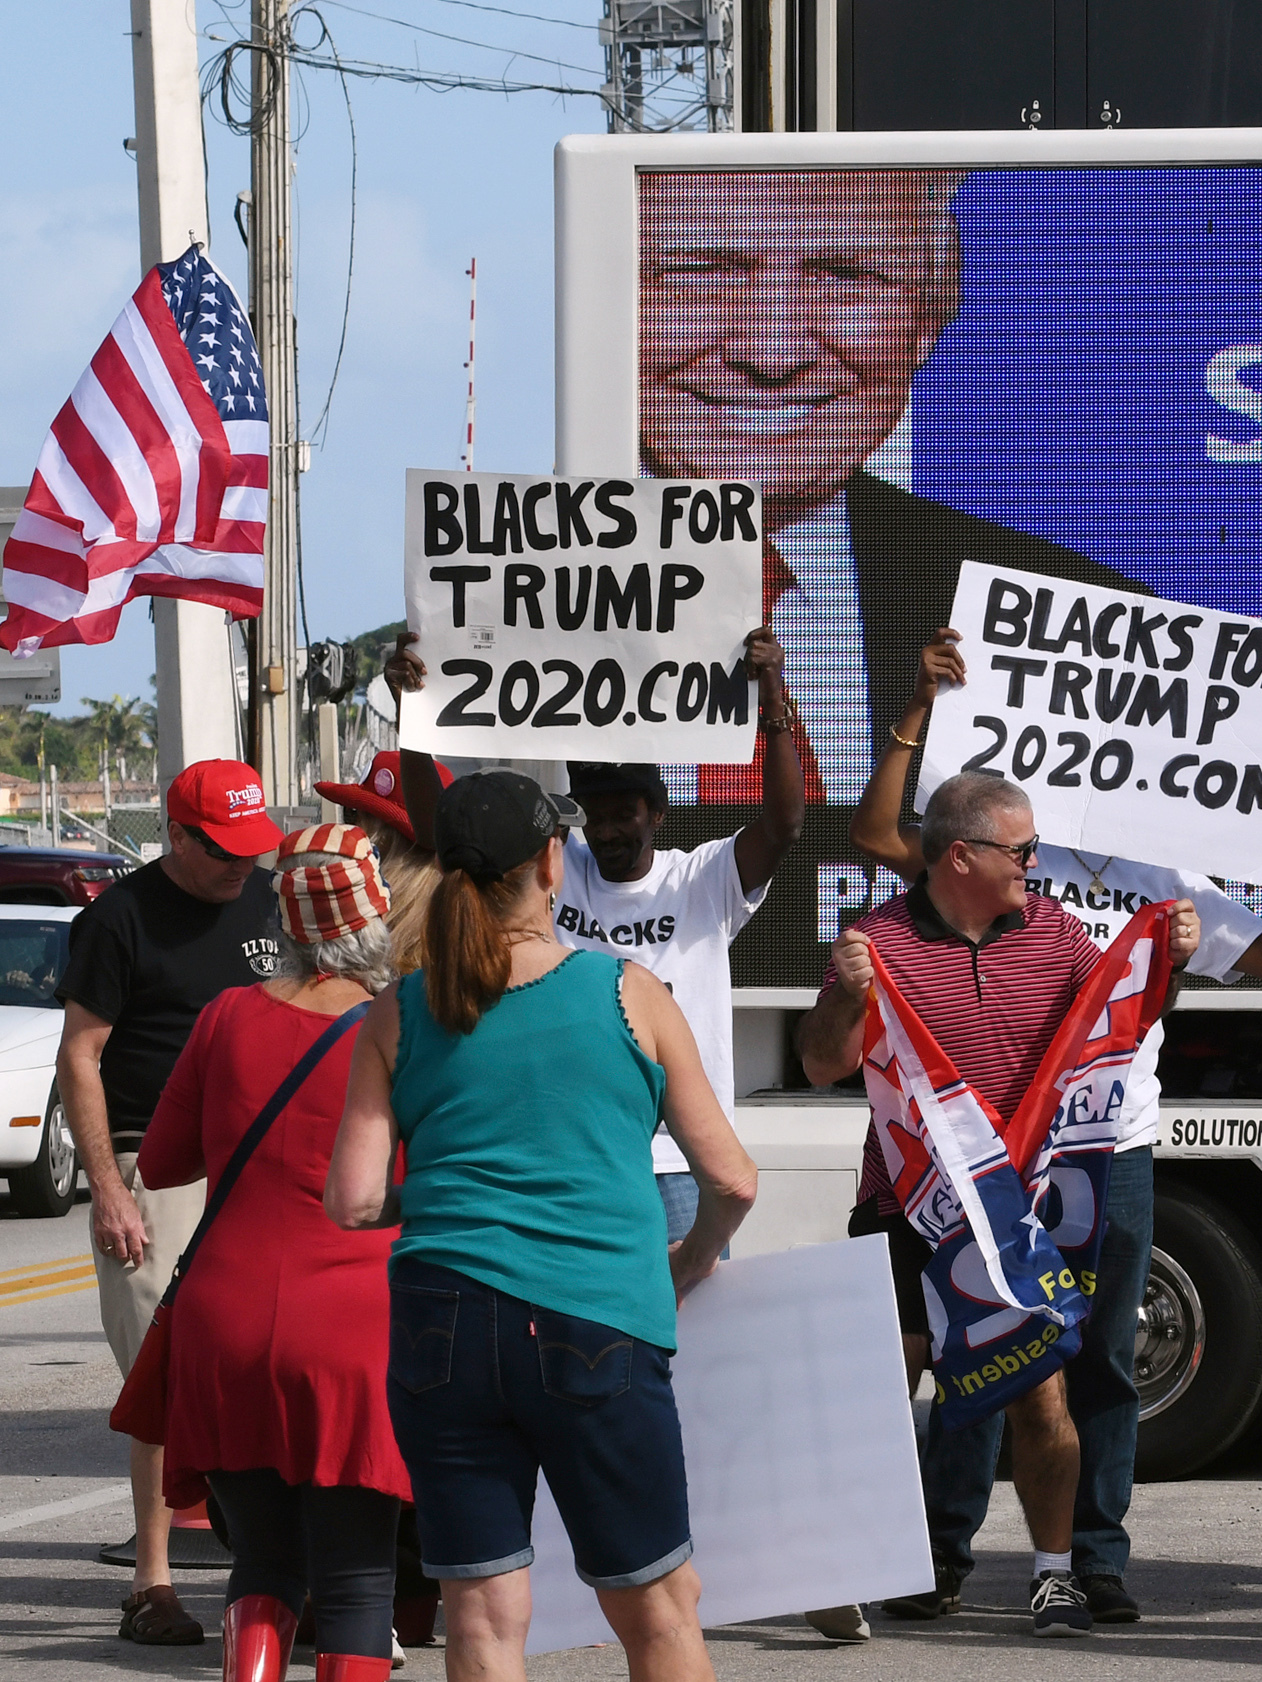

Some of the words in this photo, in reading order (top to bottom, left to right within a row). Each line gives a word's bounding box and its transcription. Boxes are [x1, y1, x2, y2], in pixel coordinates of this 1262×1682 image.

[423, 480, 637, 557] BLACKS
[659, 483, 758, 550] FOR
[429, 563, 705, 633] TRUMP
[982, 578, 1204, 672] BLACKS
[436, 658, 750, 728] 2020.COM
[990, 655, 1241, 745] TRUMP
[241, 939, 259, 957] ZZ
[556, 903, 676, 947] BLACKS
